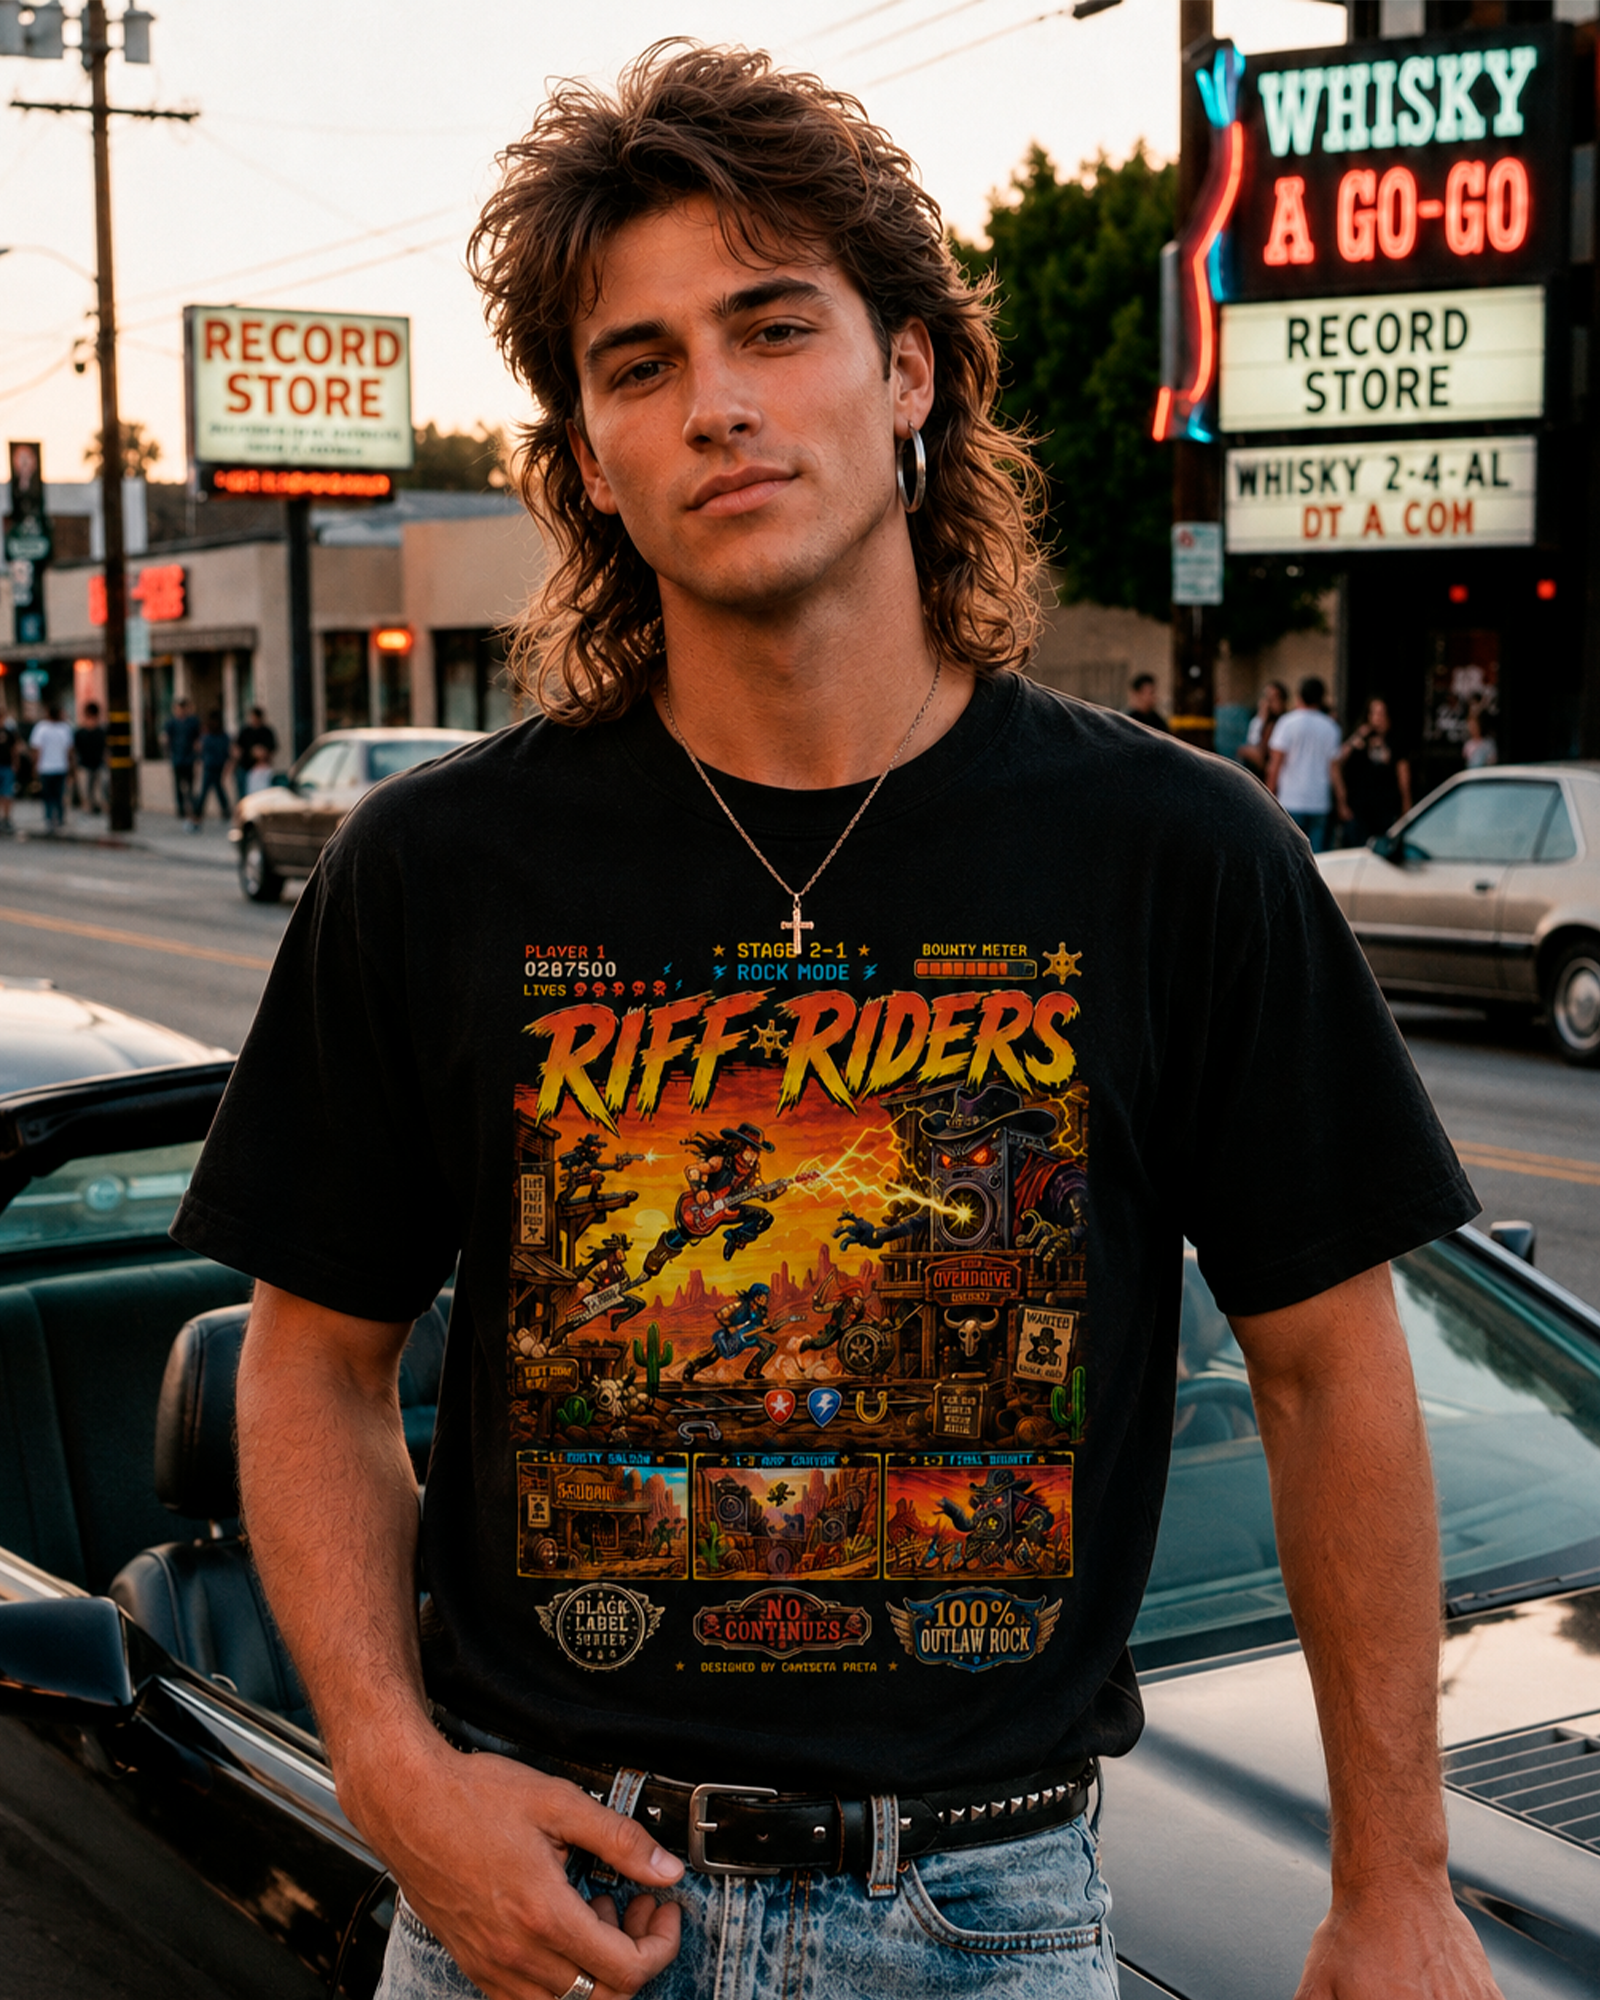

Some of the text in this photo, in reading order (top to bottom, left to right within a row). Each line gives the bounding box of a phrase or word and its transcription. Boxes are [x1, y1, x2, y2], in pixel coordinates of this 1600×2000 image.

[1258, 46, 1537, 158] WHISKY
[1263, 156, 1529, 266] A GO-GO
[204, 319, 402, 368] RECORD
[1287, 309, 1469, 360] RECORD
[226, 372, 382, 419] STORE
[1305, 365, 1450, 414] STORE
[1235, 456, 1362, 496] WHISKY
[1303, 500, 1474, 540] DT A COM
[525, 945, 605, 959] PLAYER 1
[737, 942, 847, 959] STAGE 2-1
[922, 943, 1028, 956] BOUNTY METER
[524, 961, 617, 977] 0287500
[737, 963, 850, 981] ROCK MODE
[523, 984, 567, 997] LIVES
[521, 988, 1082, 1137] RIFF RIDERS
[575, 1600, 629, 1614] BLACK
[766, 1599, 801, 1620] NO
[933, 1600, 1016, 1627] 100%
[575, 1616, 628, 1631] LABEL
[725, 1620, 841, 1641] CONTINUES
[921, 1627, 1031, 1653] OUTLAW ROCK
[761, 1662, 775, 1673] BY
